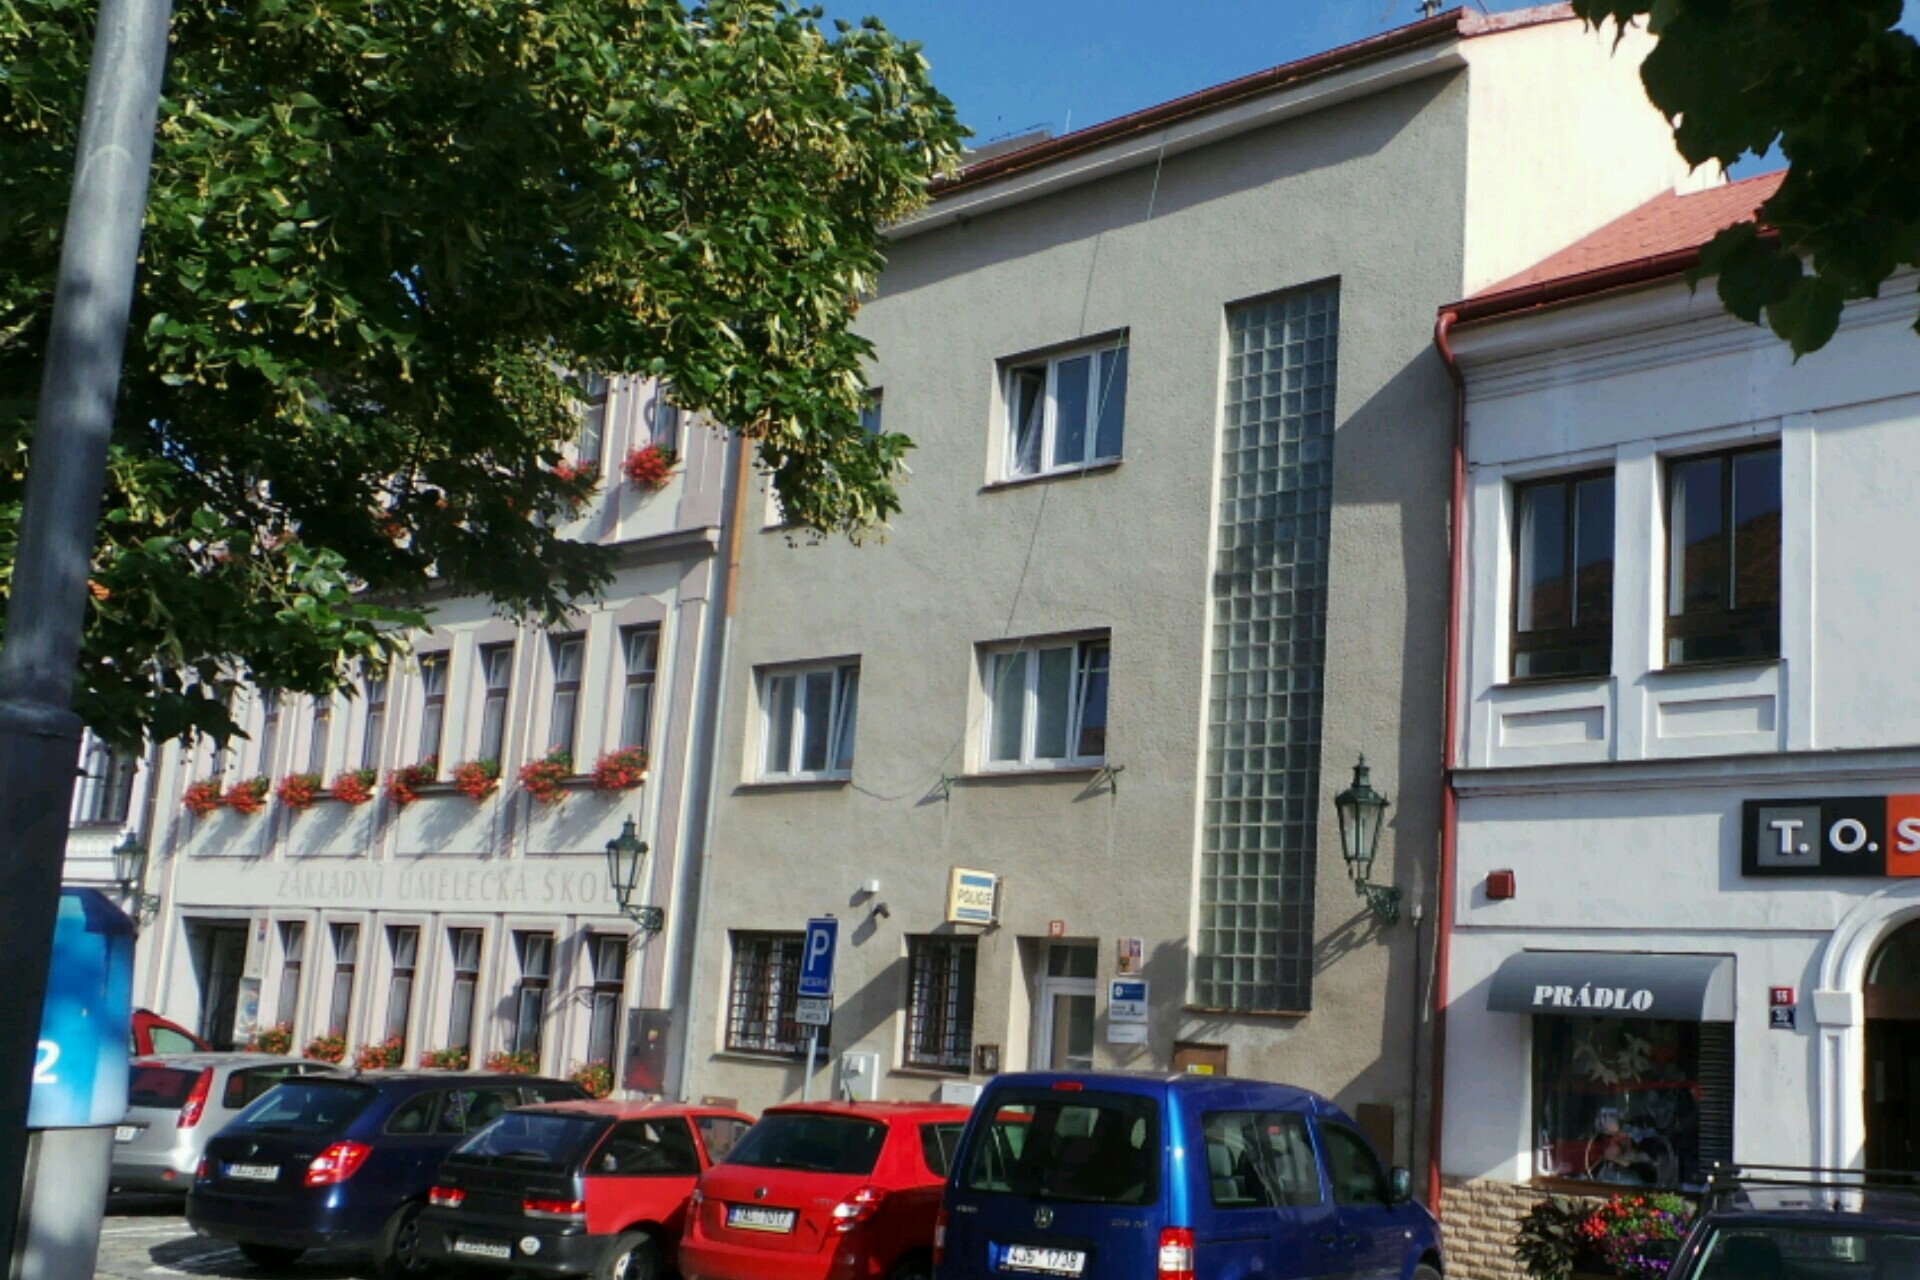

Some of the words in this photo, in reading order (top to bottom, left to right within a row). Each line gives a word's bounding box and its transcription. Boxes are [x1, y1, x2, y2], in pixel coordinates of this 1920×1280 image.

[957, 886, 993, 906] POLICIE
[808, 929, 830, 971] P
[1532, 982, 1654, 1012] PRÁDLO
[33, 1039, 60, 1084] 2
